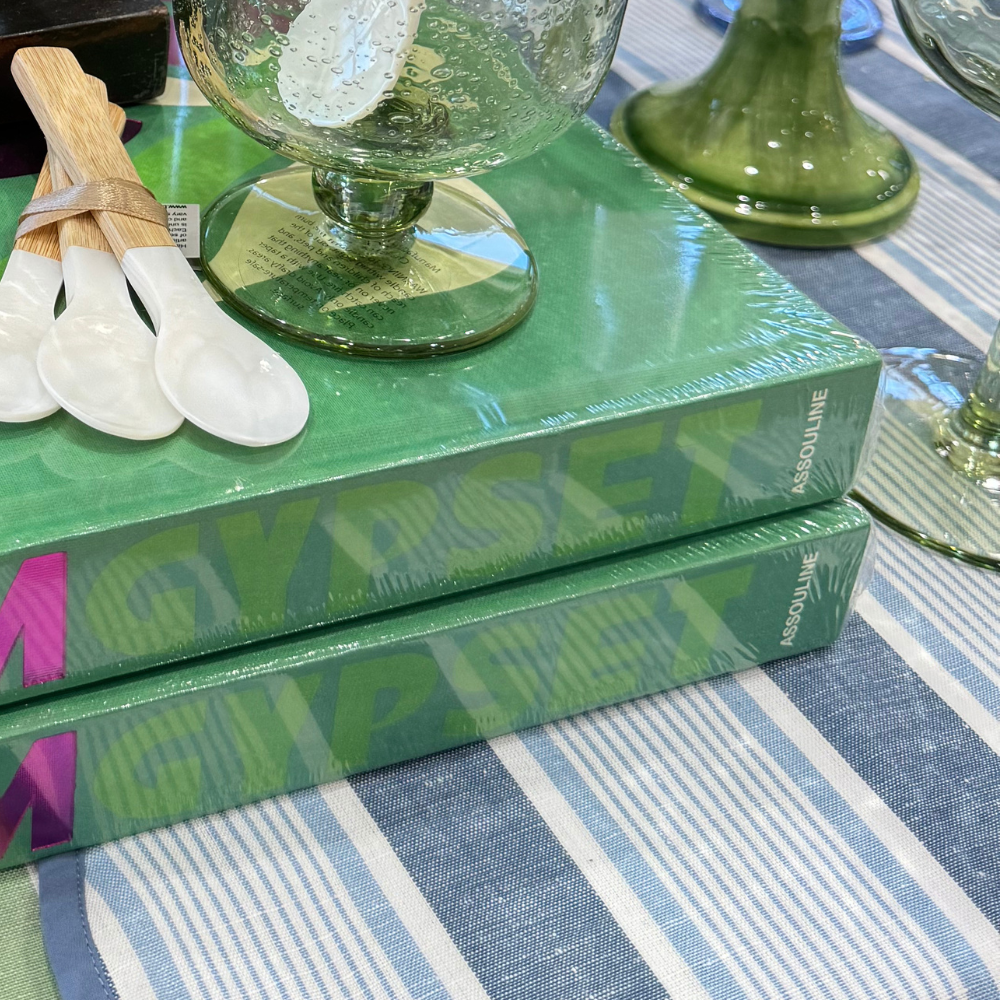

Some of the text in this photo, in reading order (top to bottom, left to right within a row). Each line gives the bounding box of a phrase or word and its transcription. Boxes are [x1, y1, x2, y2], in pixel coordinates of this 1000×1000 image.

[85, 399, 763, 657] GYPSET
[791, 388, 829, 494] ASSOULINE
[779, 551, 819, 647] ASSOULINE
[92, 564, 760, 821] GYPSET
